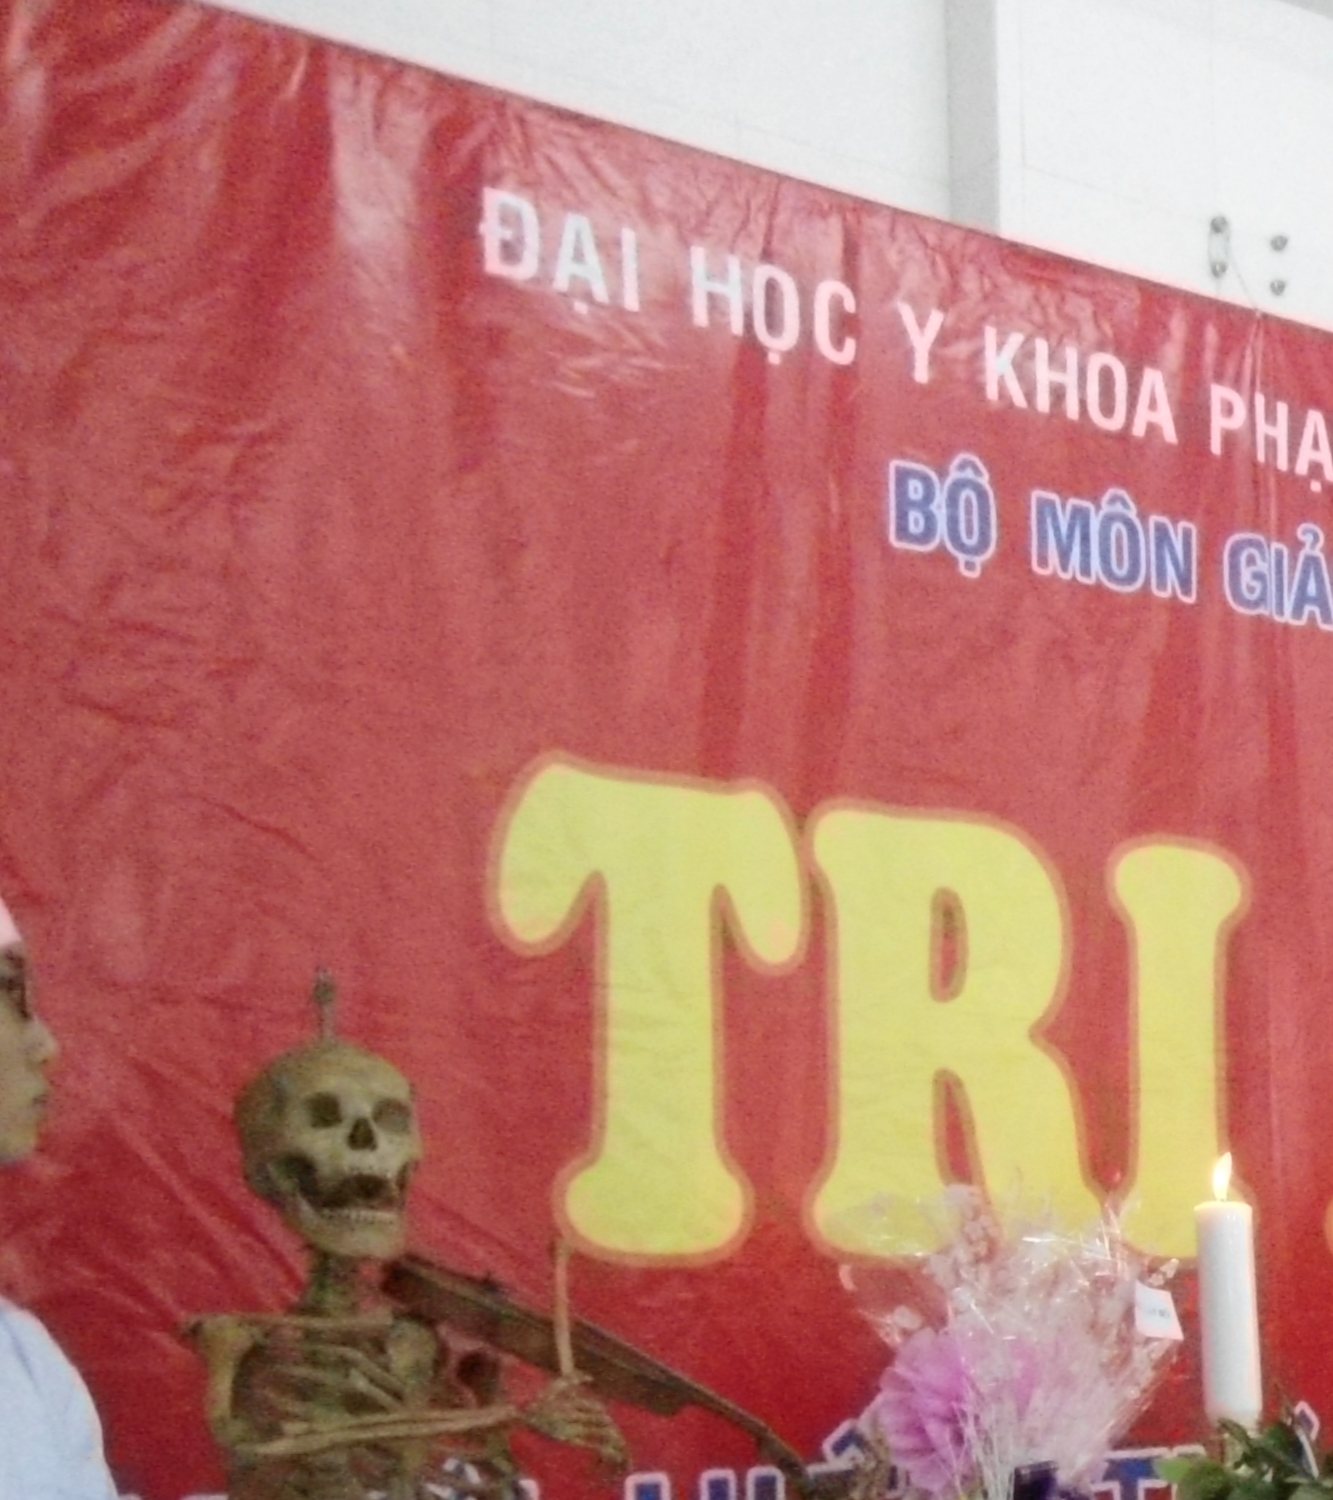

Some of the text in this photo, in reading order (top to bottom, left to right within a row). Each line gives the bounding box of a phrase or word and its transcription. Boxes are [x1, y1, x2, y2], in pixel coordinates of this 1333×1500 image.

[481, 186, 641, 316] ĐẠI
[690, 245, 857, 365] HỌC
[899, 300, 944, 384] Y
[983, 325, 1179, 445] KHOA
[888, 453, 997, 578] BỘ
[1030, 486, 1198, 604] MÔN
[488, 752, 1247, 1262] TRI
